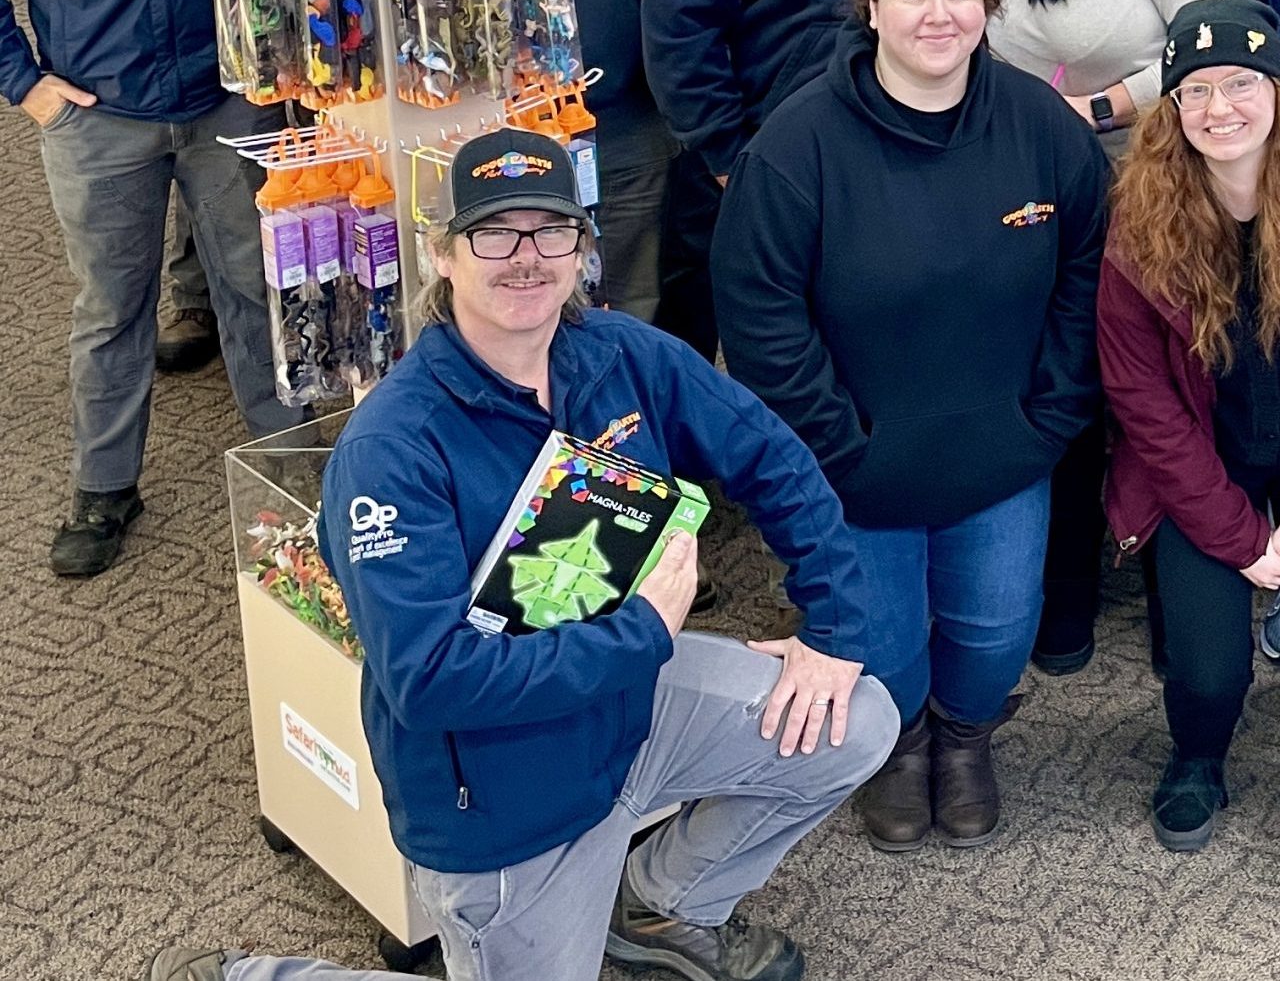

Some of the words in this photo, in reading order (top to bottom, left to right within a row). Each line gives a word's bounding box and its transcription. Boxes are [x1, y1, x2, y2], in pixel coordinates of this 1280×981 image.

[472, 157, 507, 178] GOOD
[510, 155, 552, 170] EARTH
[587, 493, 653, 523] MAGNA-TILES
[683, 507, 696, 519] 16
[352, 530, 394, 545] QualityPro
